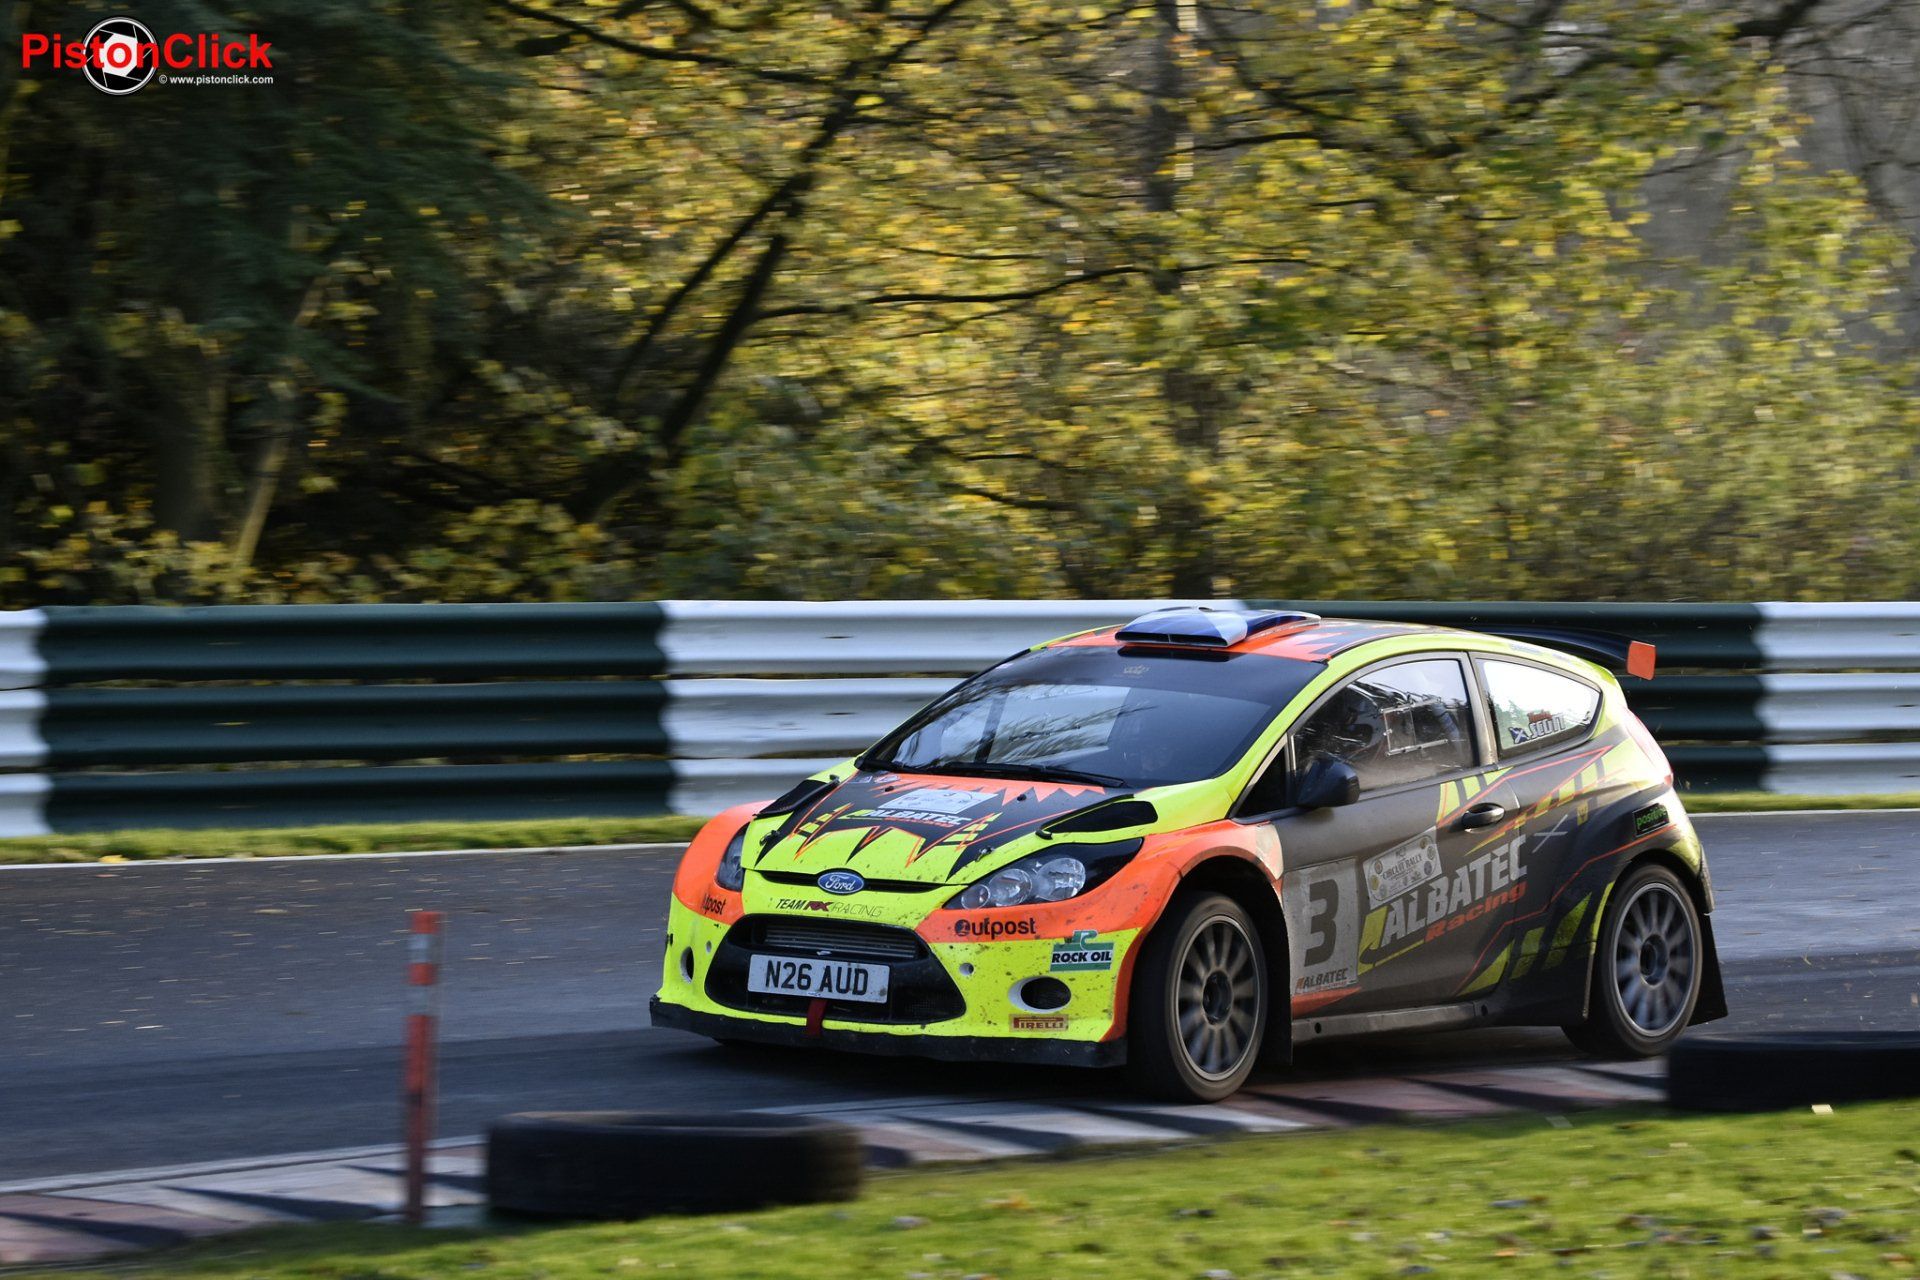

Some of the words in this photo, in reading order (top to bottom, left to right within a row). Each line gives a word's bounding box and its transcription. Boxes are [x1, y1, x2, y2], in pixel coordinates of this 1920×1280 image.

[825, 874, 856, 891] Ford
[1380, 833, 1528, 948] ALBATEC
[775, 898, 808, 911] TEAM
[830, 901, 885, 918] RACING
[1424, 881, 1529, 943] Racing
[1303, 878, 1339, 968] 3
[1051, 950, 1089, 964] ROCK
[1089, 949, 1113, 962] OIL
[765, 959, 813, 991] N26
[819, 965, 869, 996] AUD
[1302, 967, 1349, 989] ALBATEC
[1013, 1016, 1065, 1030] PIRELLI
